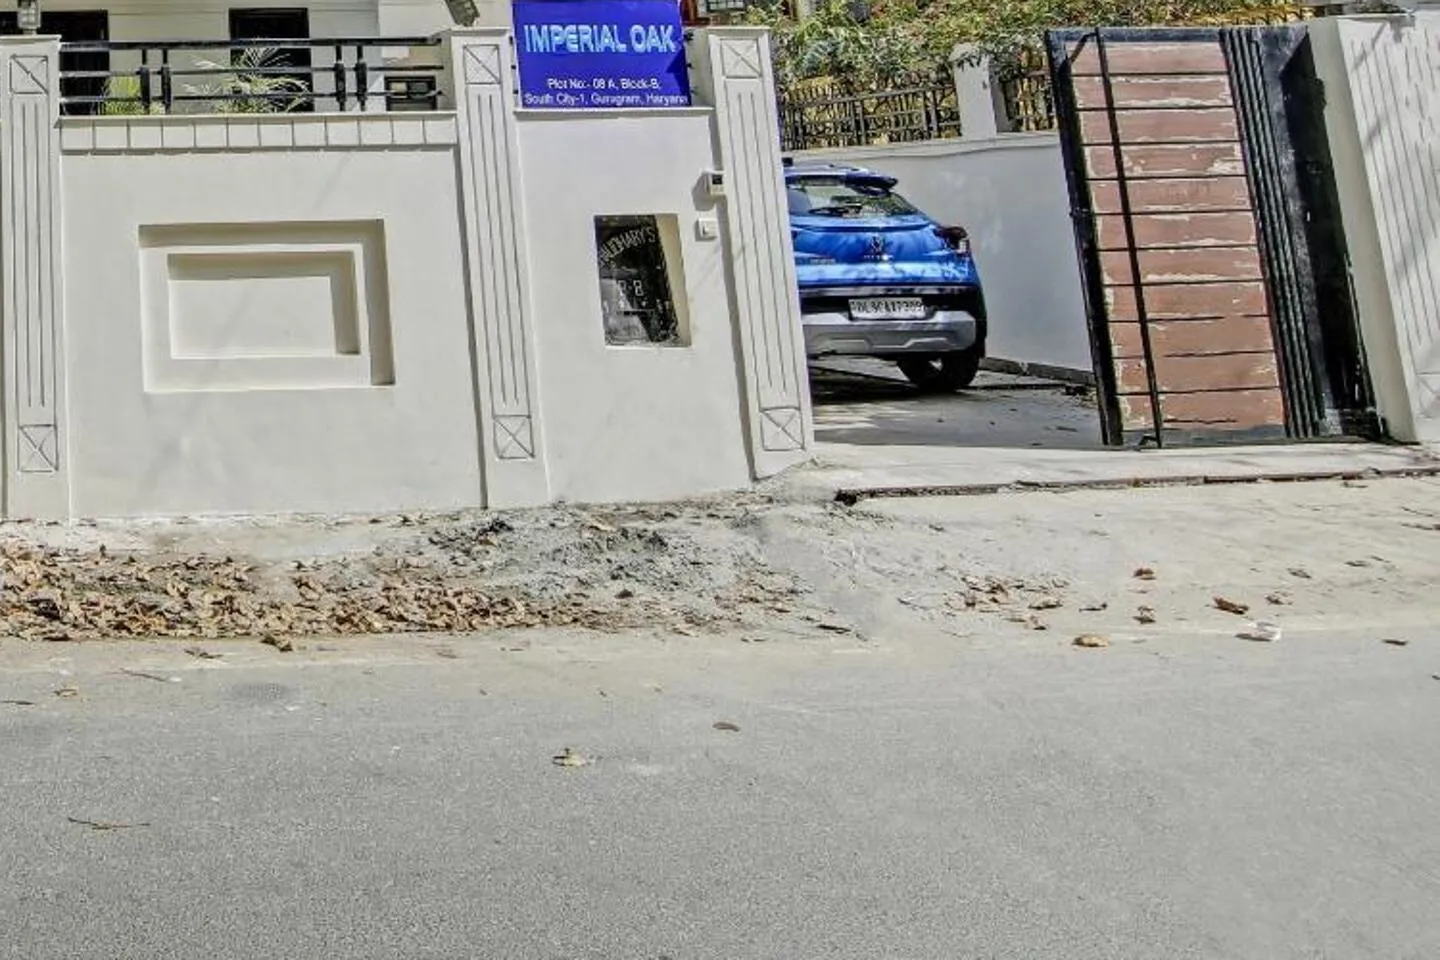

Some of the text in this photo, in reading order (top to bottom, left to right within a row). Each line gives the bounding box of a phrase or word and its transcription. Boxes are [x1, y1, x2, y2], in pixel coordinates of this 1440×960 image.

[524, 24, 676, 53] IMPERIAL OAK
[547, 78, 568, 89] Plot
[525, 93, 554, 105] South
